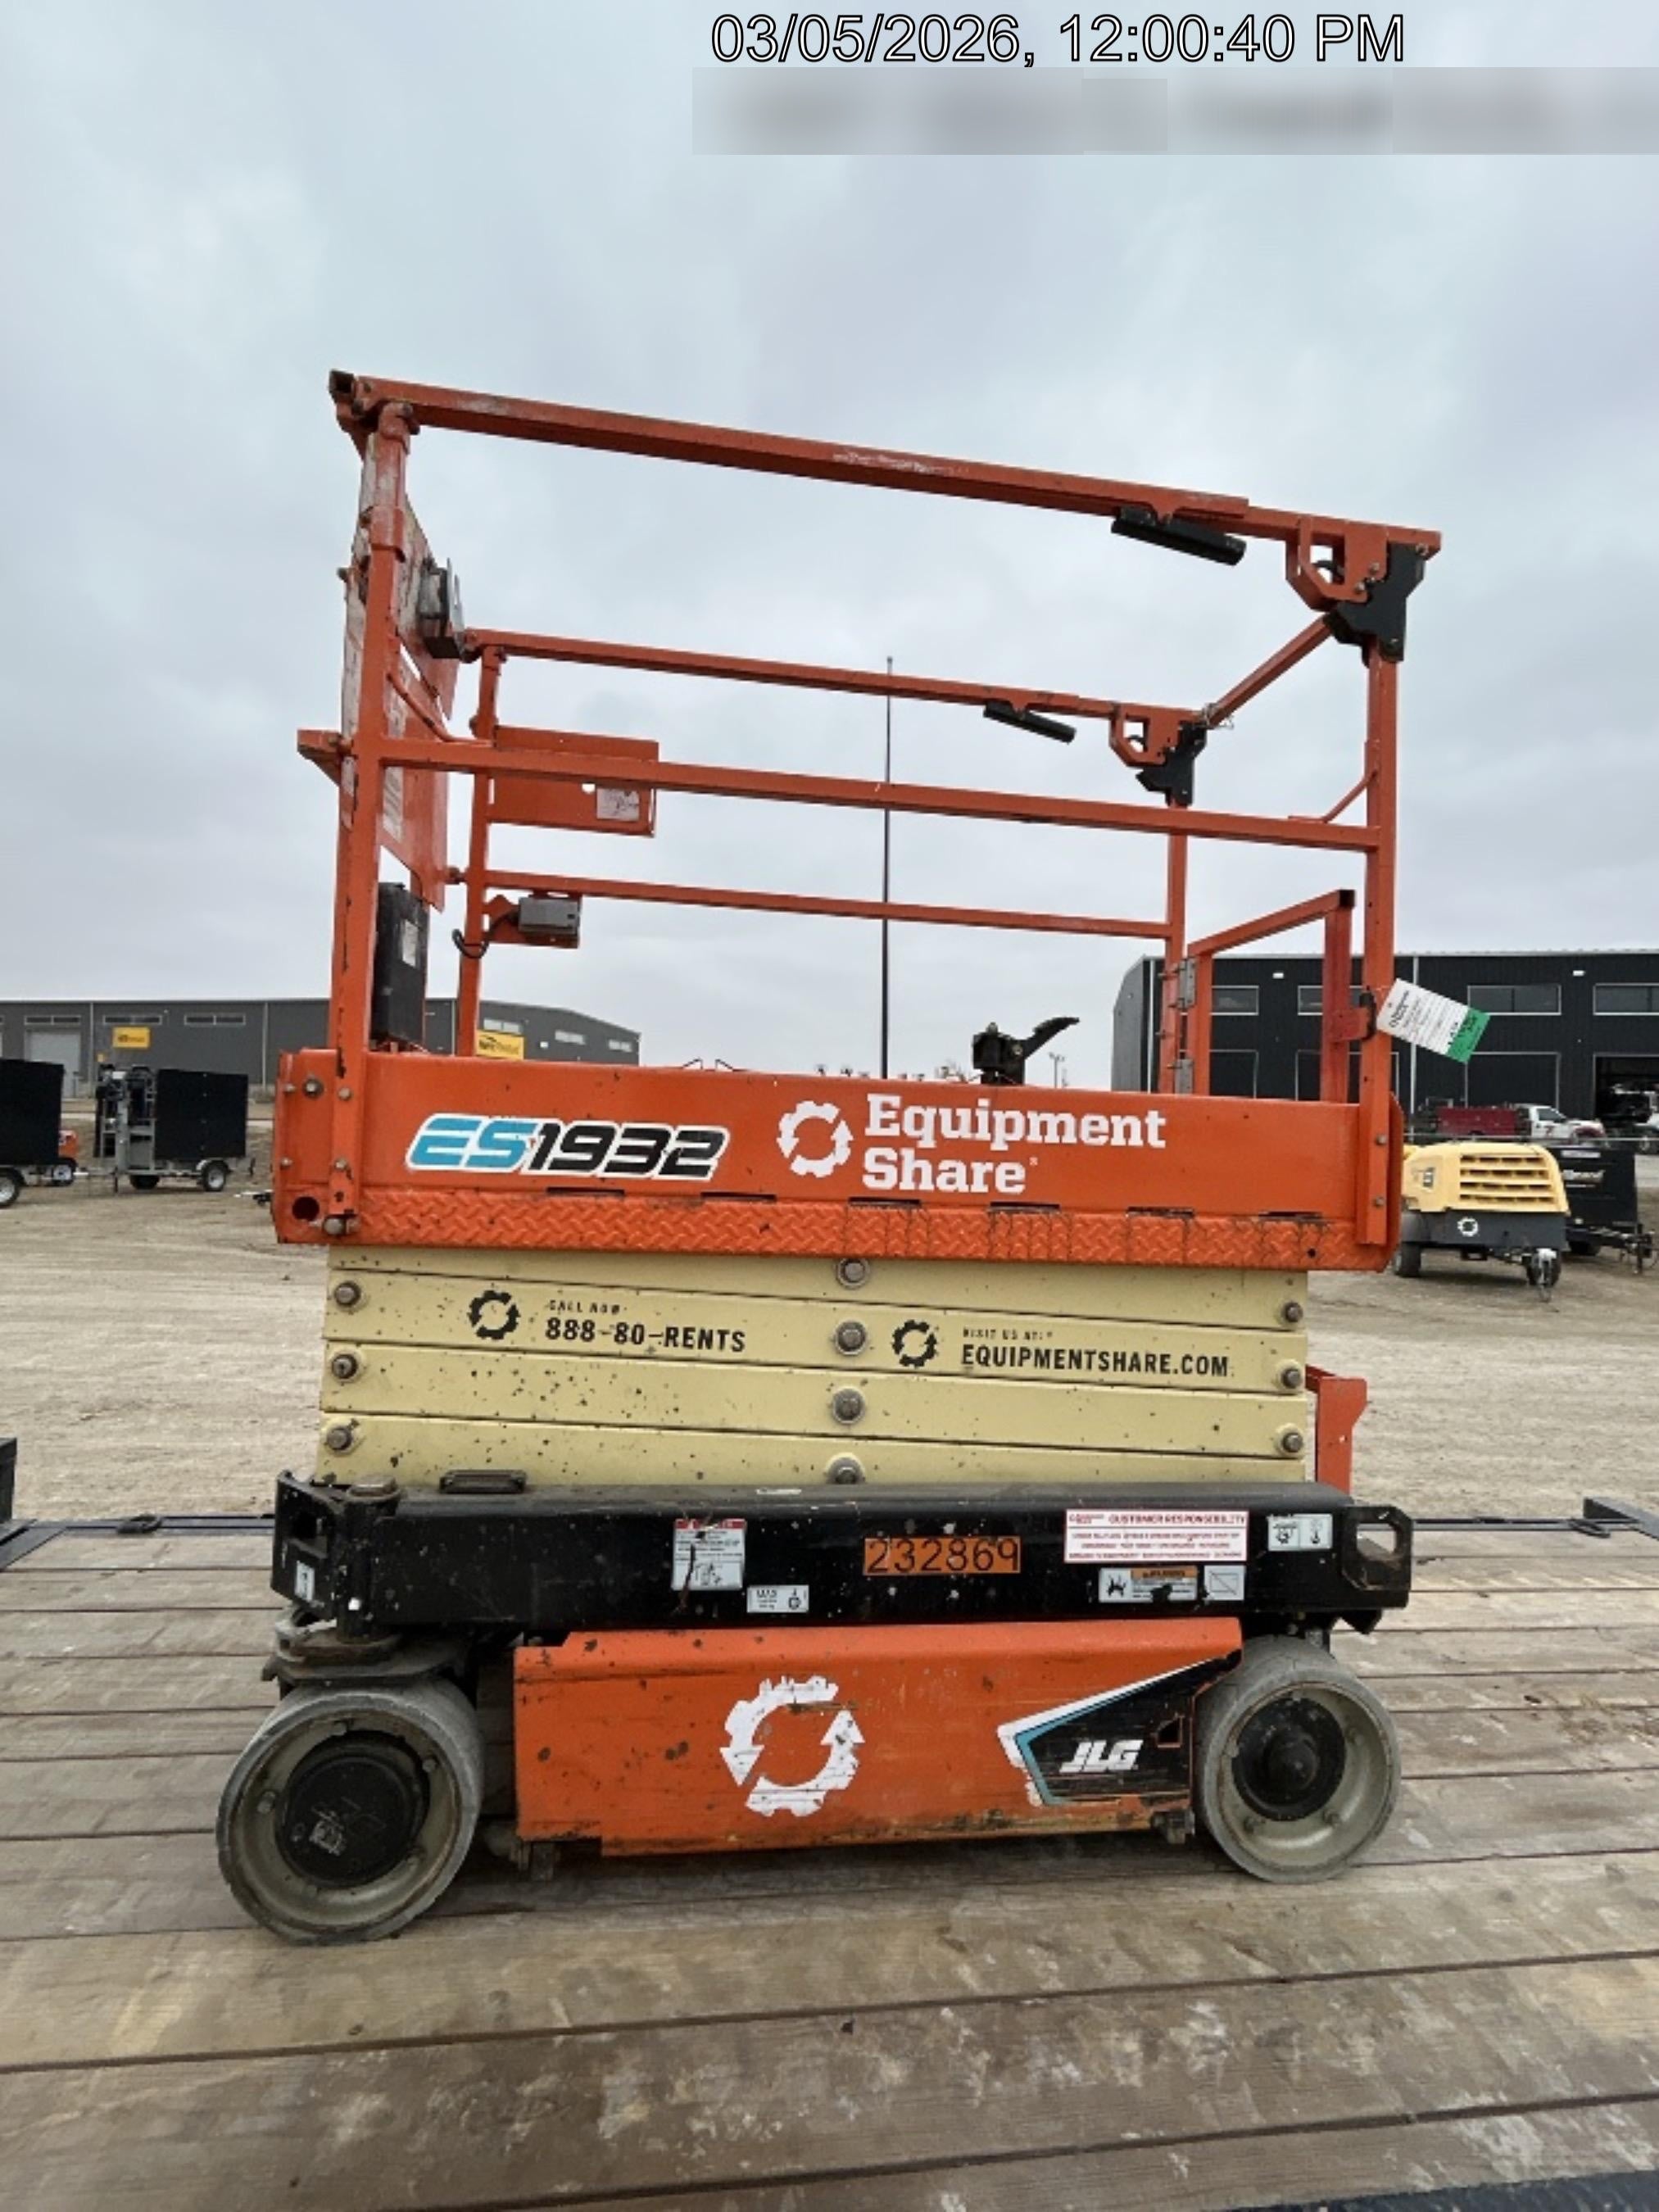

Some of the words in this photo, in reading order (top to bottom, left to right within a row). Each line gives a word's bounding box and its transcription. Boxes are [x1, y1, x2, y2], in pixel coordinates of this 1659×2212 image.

[864, 1093, 1167, 1151] Equipment
[407, 1114, 728, 1180] ES1932
[863, 1147, 1027, 1194] Share
[546, 1317, 746, 1352] 888-80-RENTS
[961, 1344, 1228, 1377] EQUIPMENTSHARE.COM
[867, 1538, 1018, 1573] 232869
[1058, 1738, 1144, 1774] JLG
